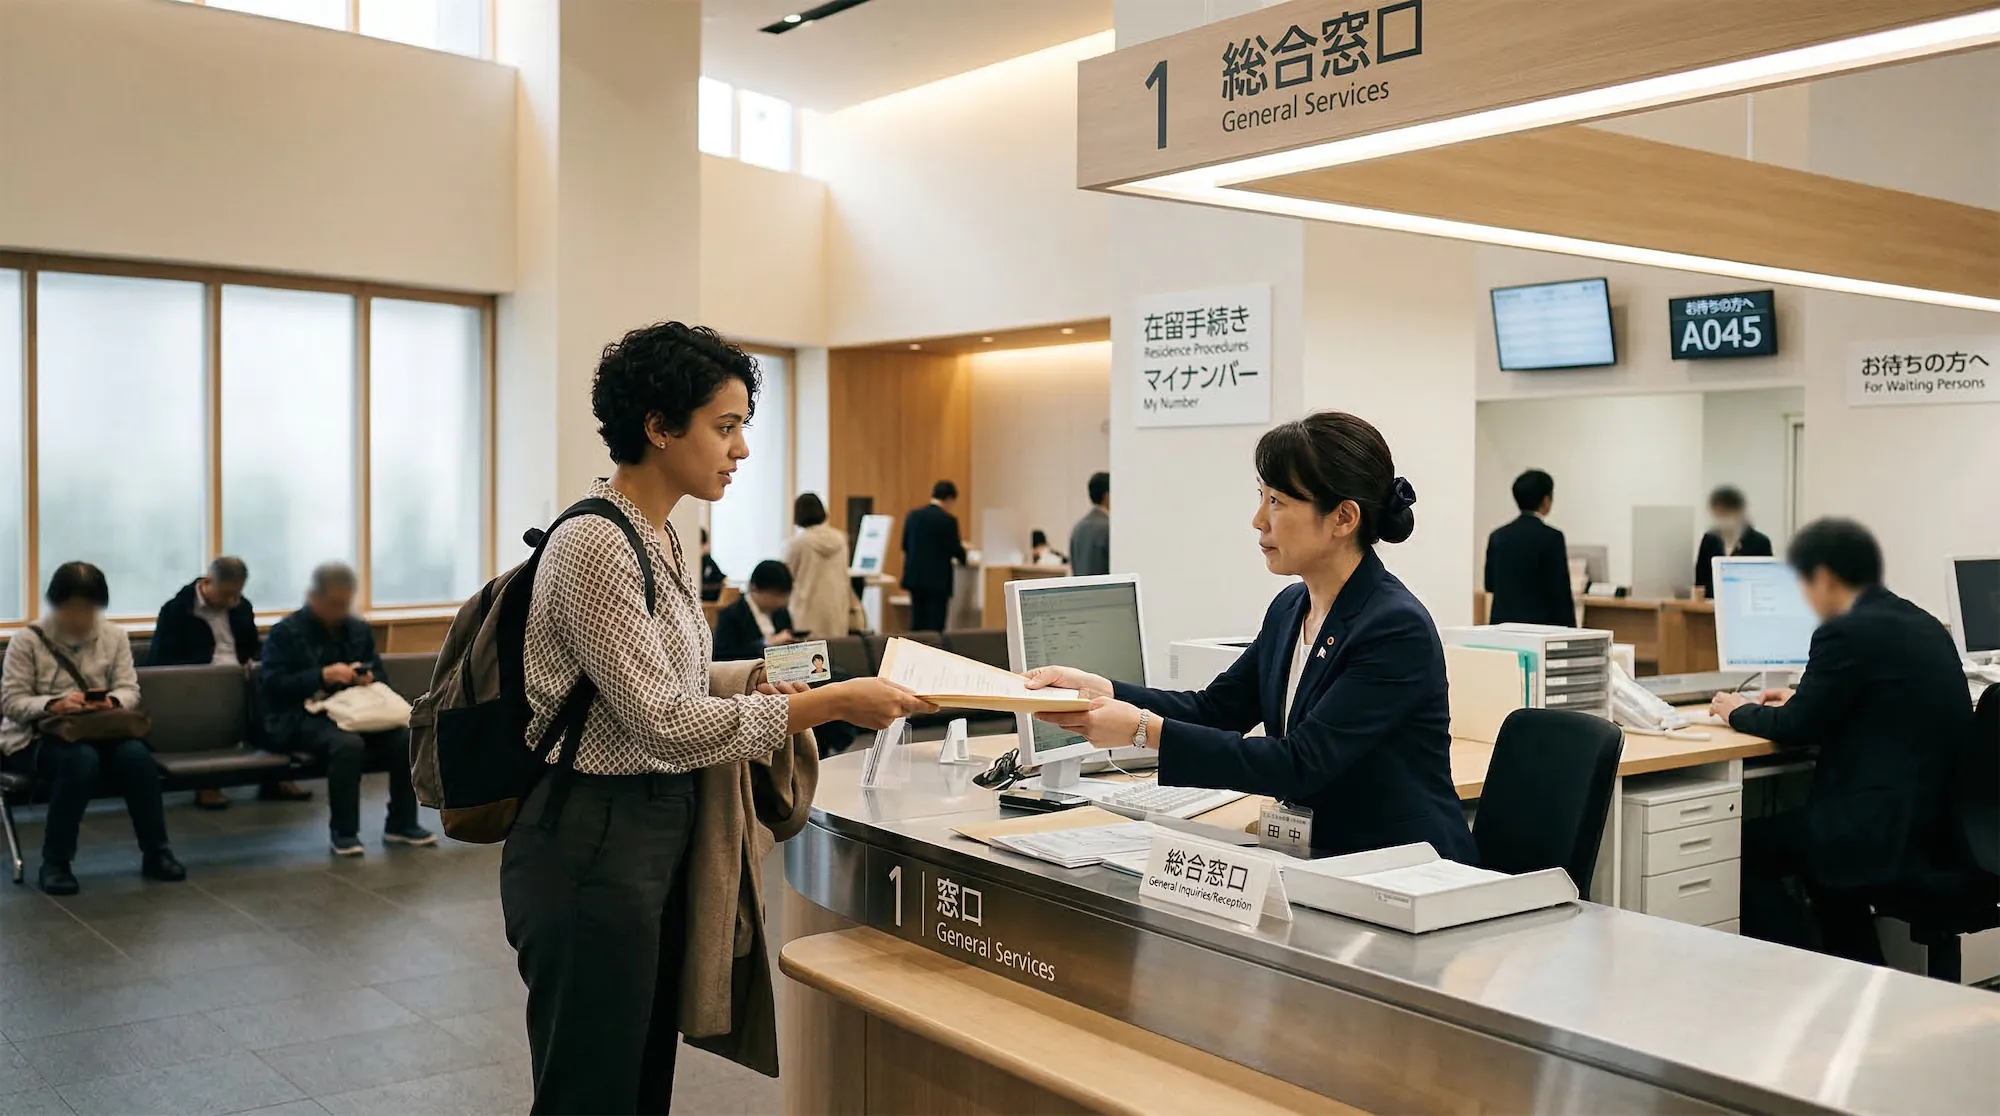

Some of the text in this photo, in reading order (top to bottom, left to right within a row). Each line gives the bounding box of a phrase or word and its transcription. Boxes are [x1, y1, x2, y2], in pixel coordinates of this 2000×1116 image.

[1221, 0, 1423, 102] 総合窓口
[1145, 59, 1168, 150] 1
[1222, 79, 1390, 133] General Services
[1144, 305, 1250, 342] 在留手続き
[1685, 297, 1755, 316] お待ちの方へ
[1144, 341, 1249, 359] Residence Procedures
[1681, 315, 1762, 352] A045
[1144, 360, 1258, 392] マイナンバー
[1862, 351, 1990, 376] お待ちの方へ
[1144, 396, 1199, 412] My Number
[1864, 378, 1985, 393] For Waiting Persons
[1164, 848, 1249, 893] 総合窓口
[888, 865, 902, 927] 1
[936, 878, 982, 927] 窓口
[1149, 876, 1252, 911] General Inquiries/Reception
[936, 922, 1056, 982] General Services
